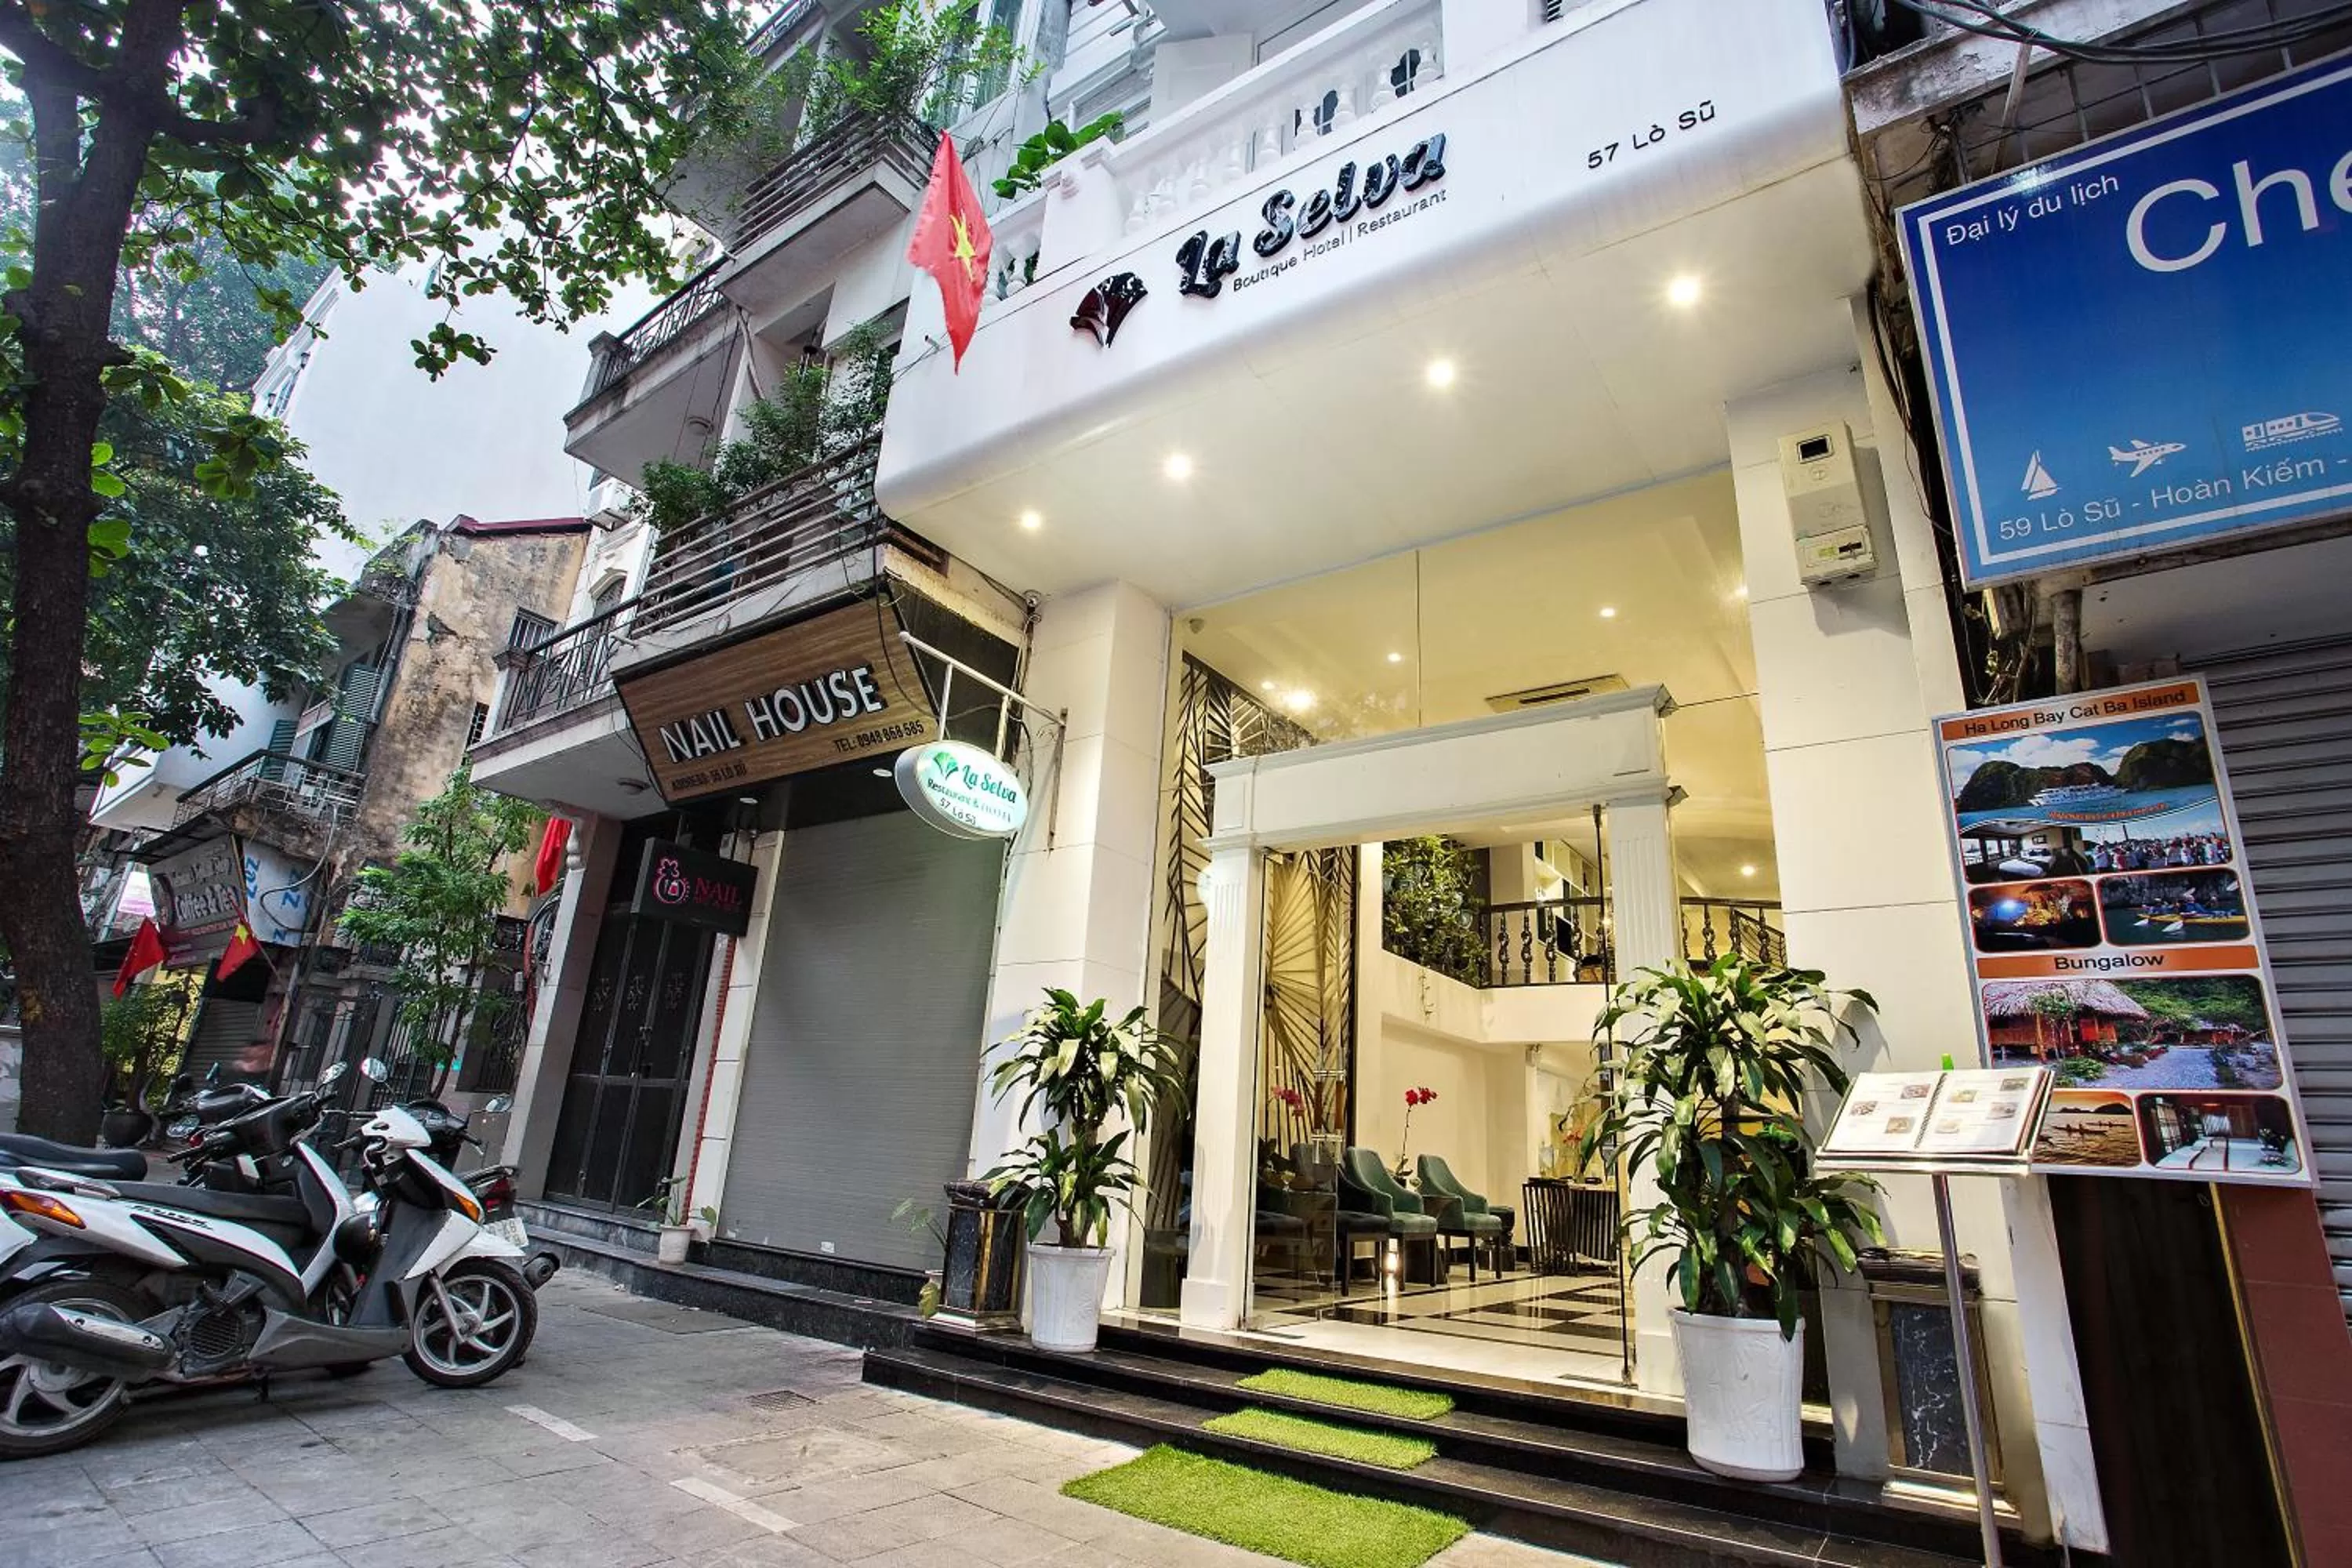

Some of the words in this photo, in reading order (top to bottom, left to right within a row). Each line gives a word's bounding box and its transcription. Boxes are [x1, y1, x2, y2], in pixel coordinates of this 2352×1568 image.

[1588, 142, 1619, 169] 57
[1175, 230, 1242, 299] La
[1252, 132, 1447, 258] Selva
[1945, 215, 1991, 245] Đại
[1997, 205, 2020, 231] lý
[2028, 196, 2062, 219] du
[2070, 175, 2120, 206] lịch
[1232, 257, 1298, 292] Boutique
[1303, 230, 1345, 261] Hotel
[1356, 188, 1447, 238] Restaurant
[1999, 516, 2032, 541] 59
[2041, 509, 2075, 532] Lò
[2083, 497, 2122, 523] Sũ
[2151, 476, 2232, 510] Hoàn
[2241, 456, 2325, 491] Kiếm
[659, 710, 742, 764] NAIL
[744, 666, 883, 742] HOUSE
[1963, 722, 1987, 737] Ha
[1991, 714, 2031, 732] Long
[2032, 709, 2066, 726] Bay
[2069, 702, 2100, 720] Cat
[2103, 699, 2128, 714] Ba
[2132, 689, 2187, 710] Island
[940, 797, 951, 810] 57
[962, 764, 980, 790] La
[980, 772, 1018, 804] Selva
[2053, 953, 2165, 971] Bungalow
